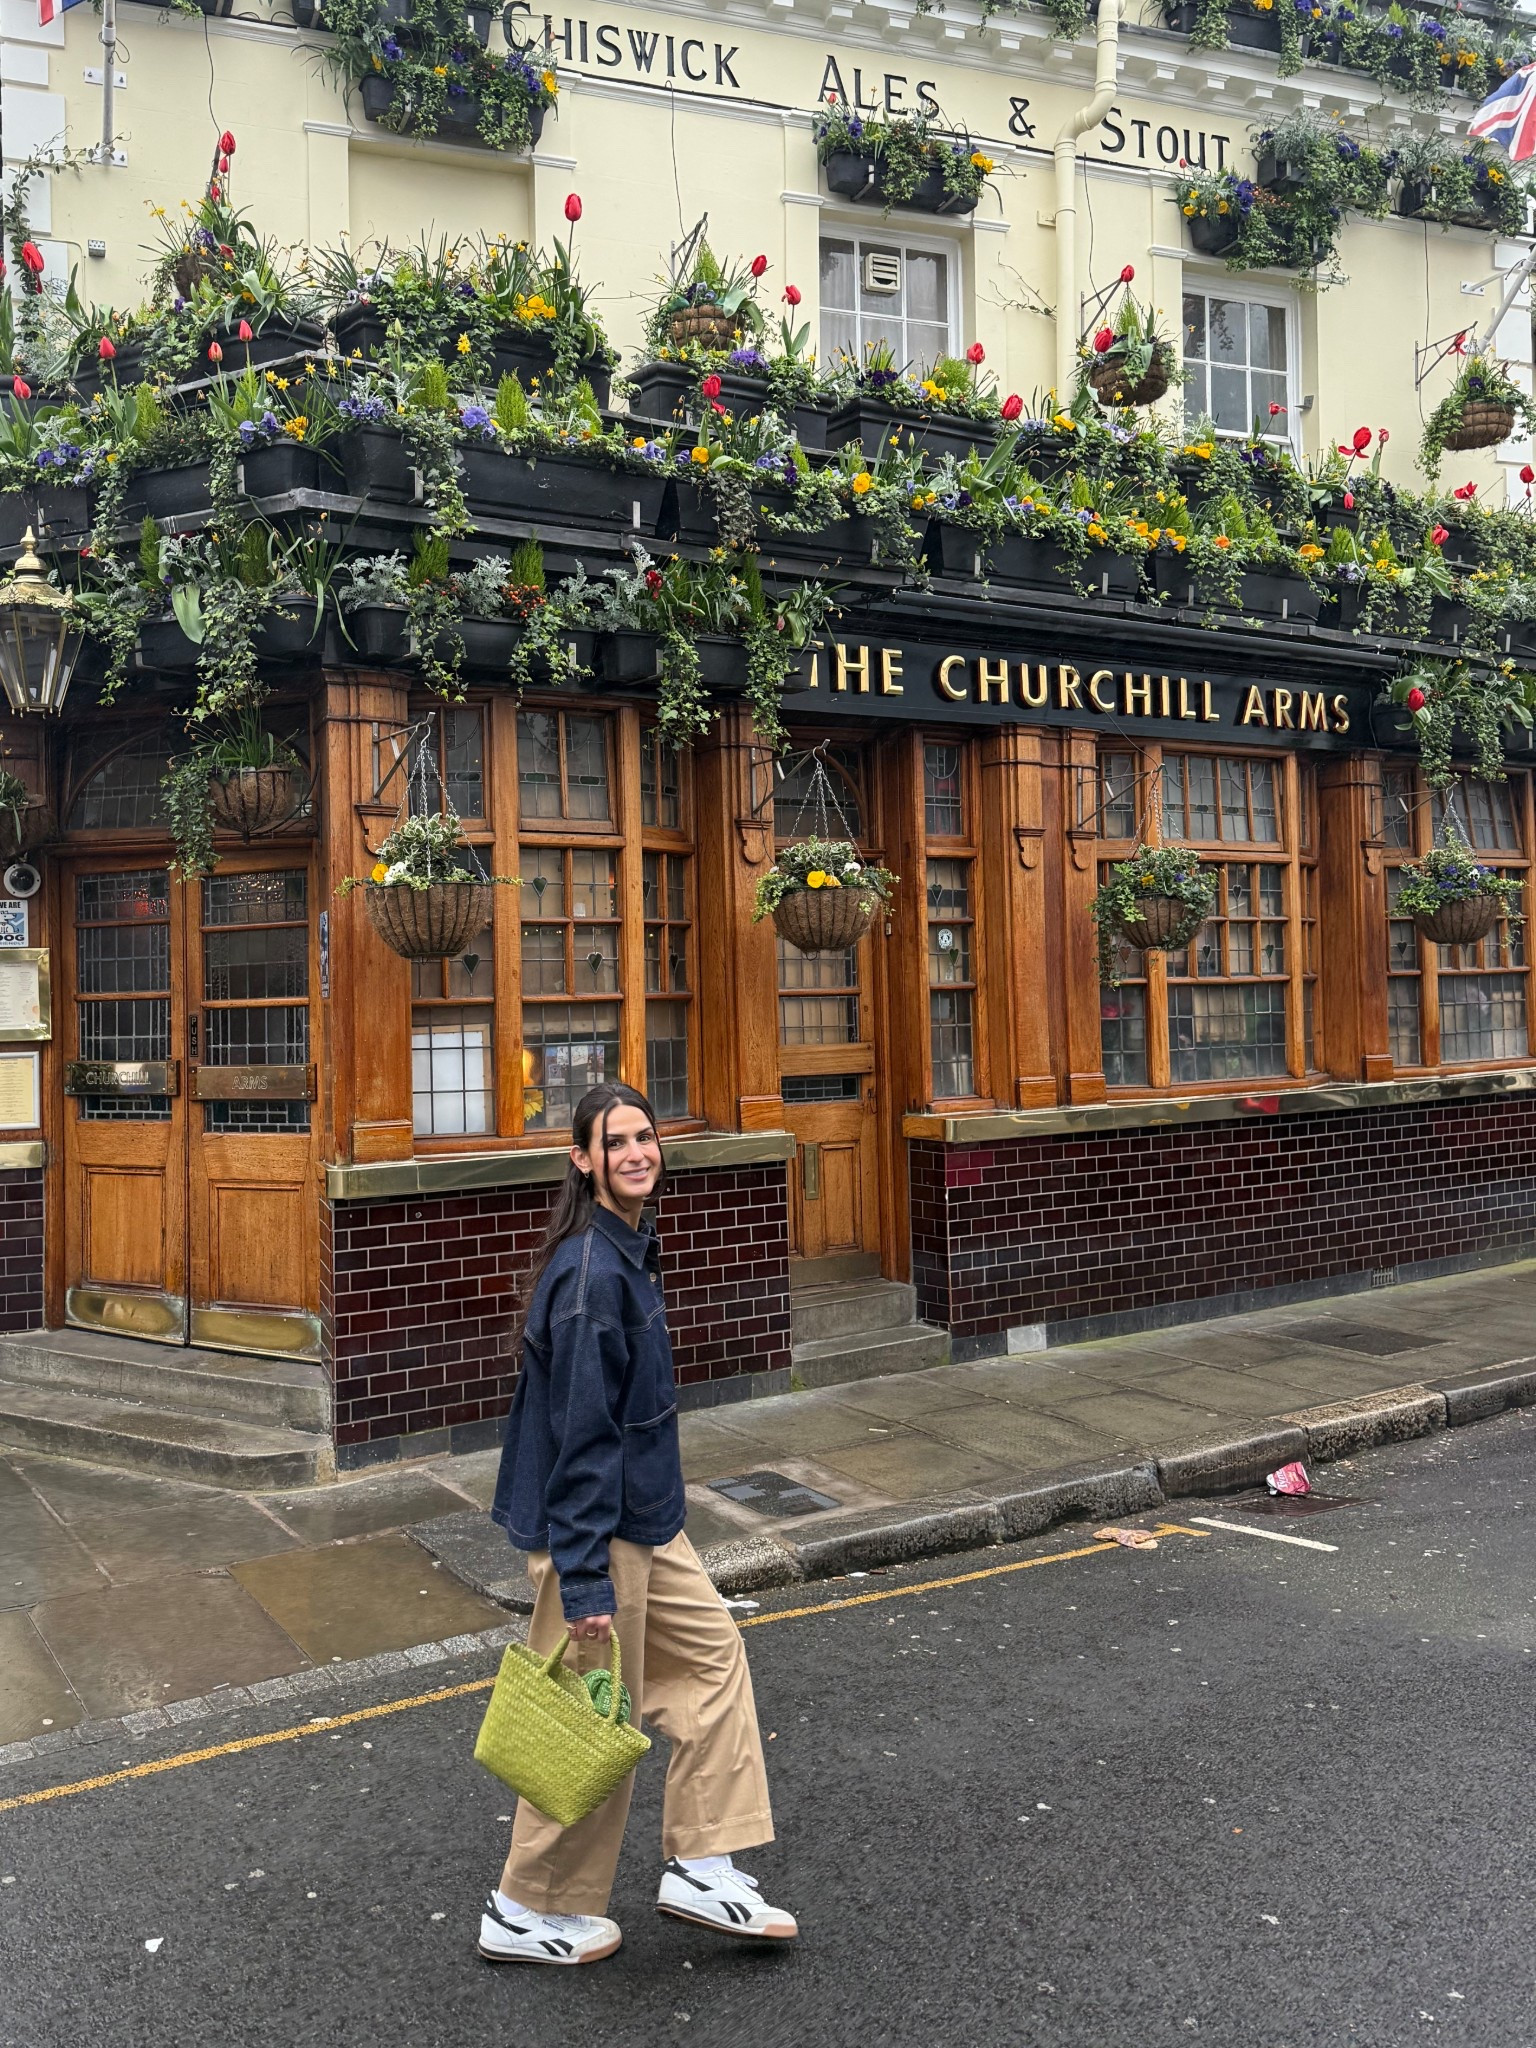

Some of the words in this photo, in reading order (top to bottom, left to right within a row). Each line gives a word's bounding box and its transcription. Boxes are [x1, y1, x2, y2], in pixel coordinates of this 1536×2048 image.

[502, 1, 740, 88] CHISWICK
[817, 55, 940, 119] ALES
[1008, 96, 1036, 139] &
[1100, 106, 1230, 172] STOUT
[938, 655, 1220, 722] CHURCHILL
[1243, 685, 1349, 734] ARMS
[85, 1071, 151, 1086] CHURCHILL
[231, 1075, 268, 1090] ARMS
